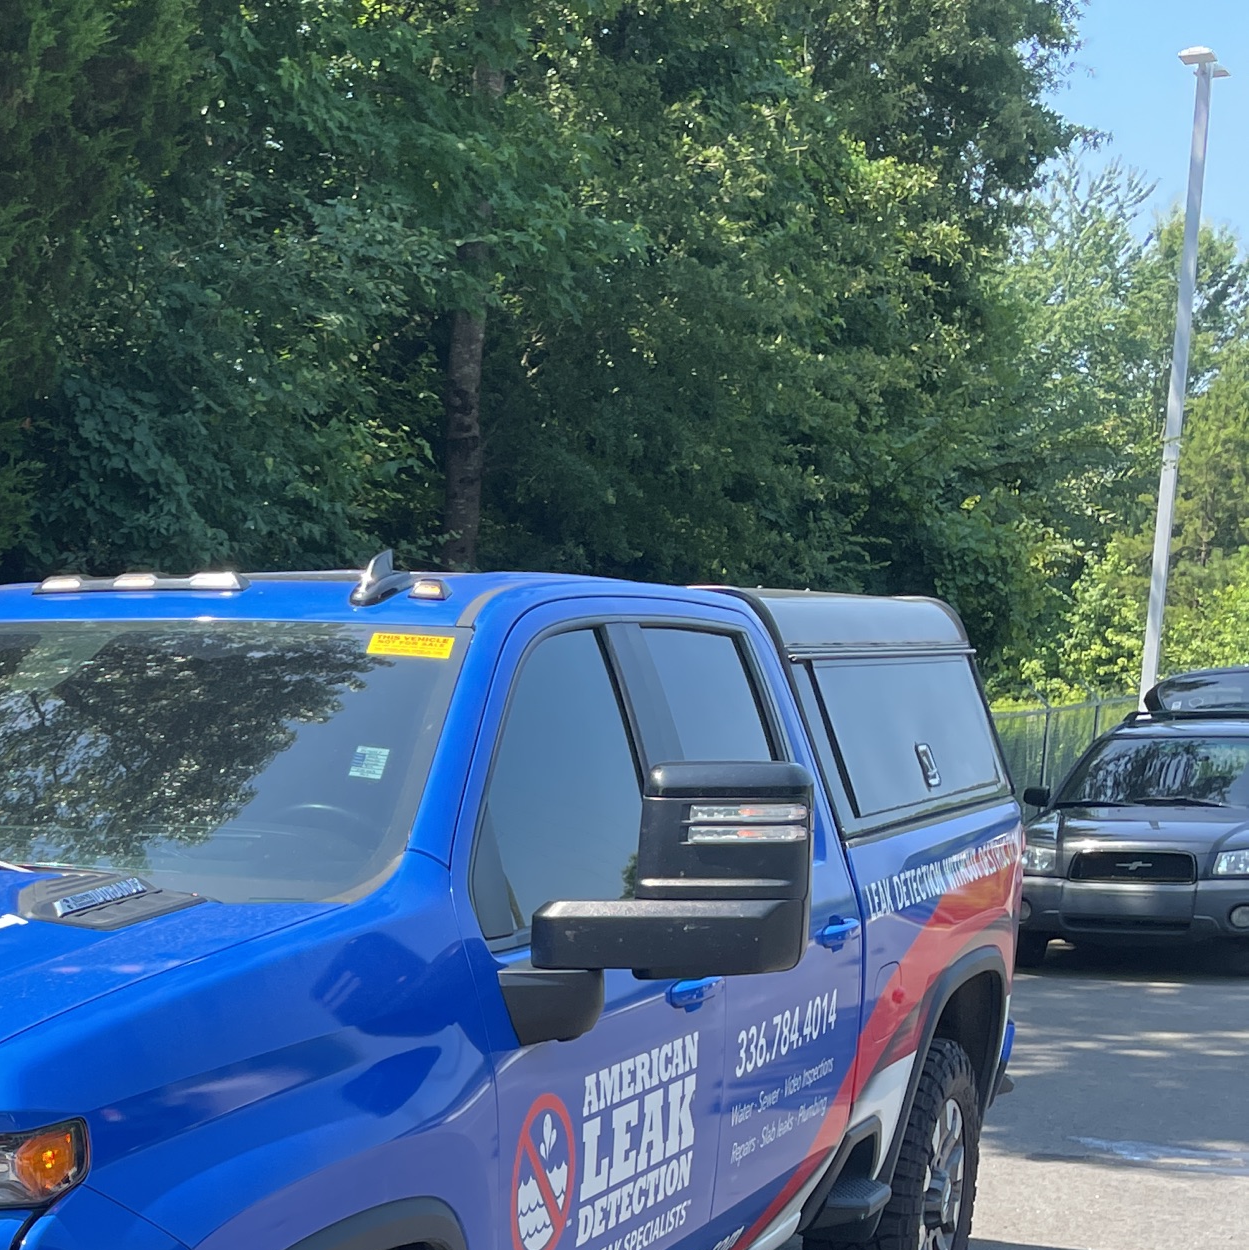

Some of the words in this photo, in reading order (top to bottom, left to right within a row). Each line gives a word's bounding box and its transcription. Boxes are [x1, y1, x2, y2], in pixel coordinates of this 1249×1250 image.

[865, 876, 895, 921] LEAK
[892, 861, 947, 911] DETECTION
[582, 1031, 699, 1117] AMERICAN
[735, 988, 838, 1078] 336.784.4014
[730, 1136, 756, 1167] Repairs
[760, 1120, 776, 1148] Slab
[797, 1096, 828, 1126] Plumbing
[731, 1102, 754, 1127] Water
[757, 1088, 781, 1113] Sewer
[784, 1073, 802, 1098] Video
[802, 1057, 835, 1088] Inspections
[579, 1073, 697, 1203] LEAK
[575, 1150, 693, 1248] DETECTION
